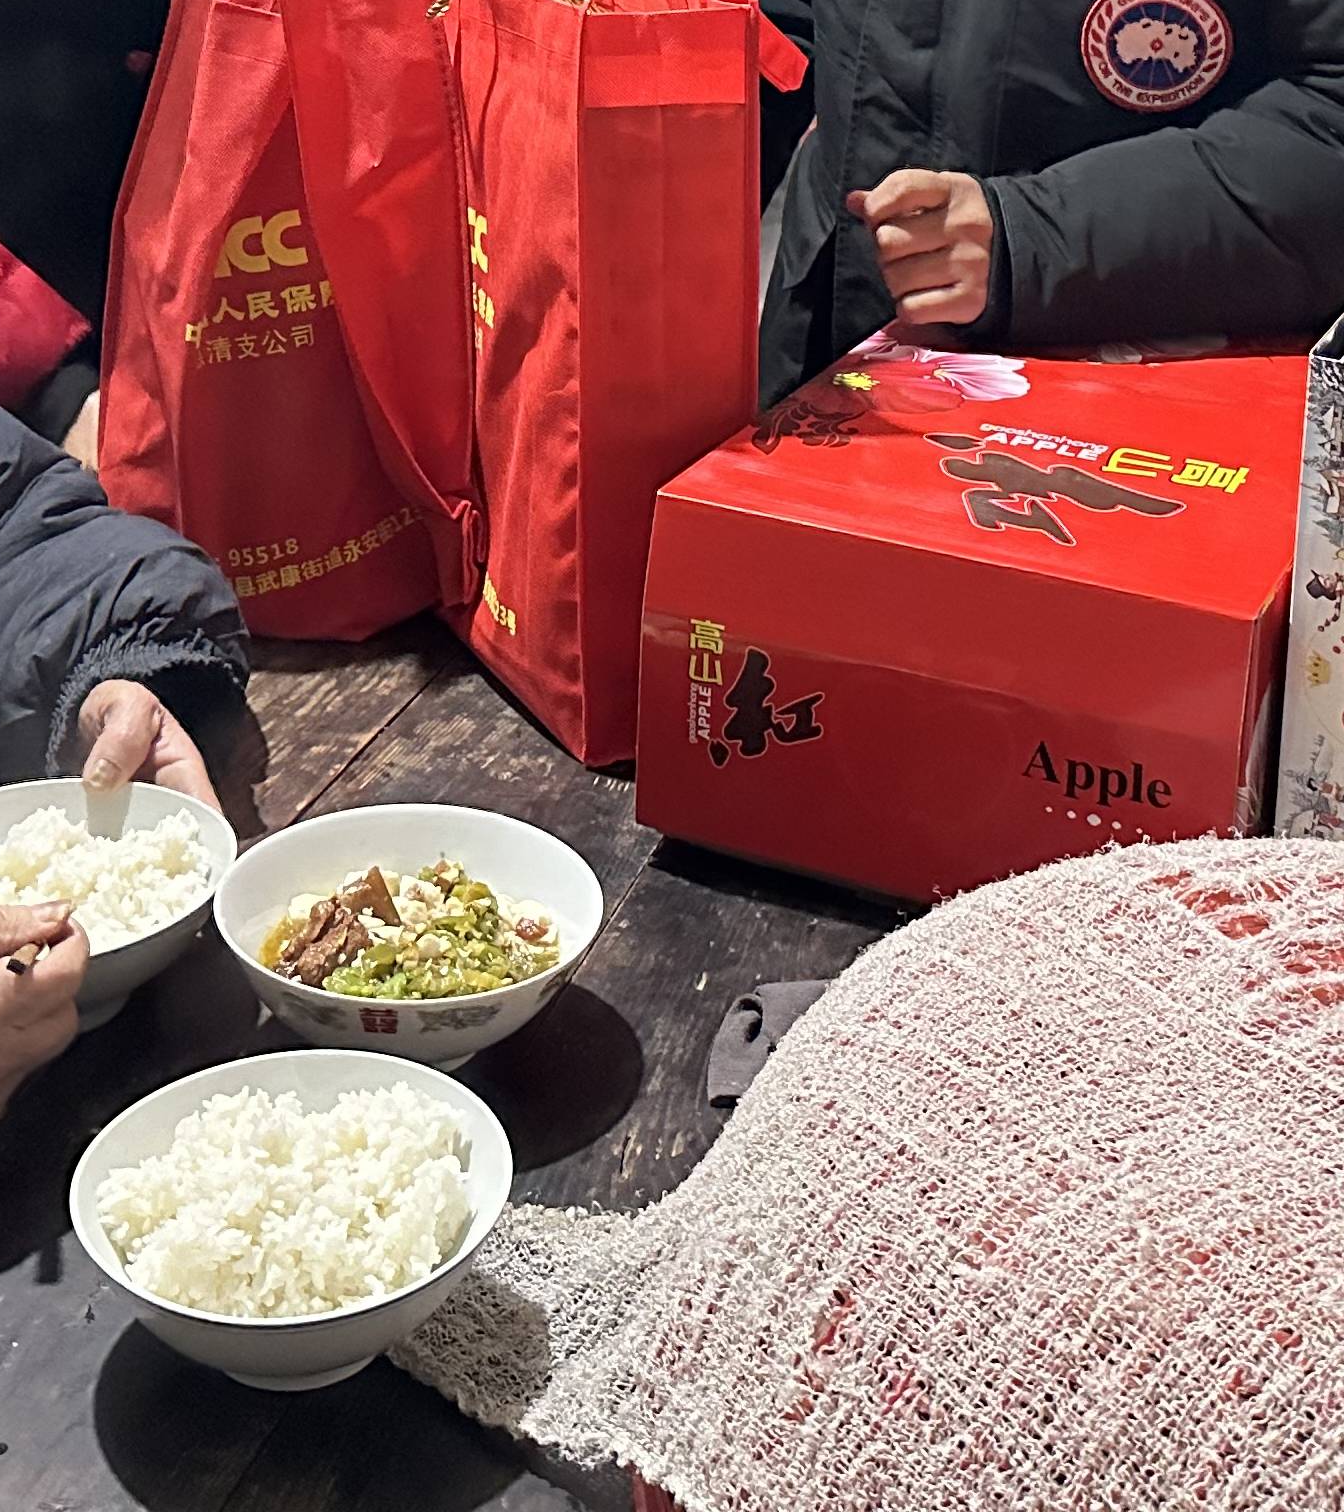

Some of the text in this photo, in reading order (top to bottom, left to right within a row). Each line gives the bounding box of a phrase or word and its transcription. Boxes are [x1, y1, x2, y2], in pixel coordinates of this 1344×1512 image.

[984, 432, 1098, 461] APPLE
[228, 538, 299, 567] 95518
[688, 618, 726, 686] 高山
[697, 685, 712, 741] APPLE
[1022, 740, 1173, 809] Apple
